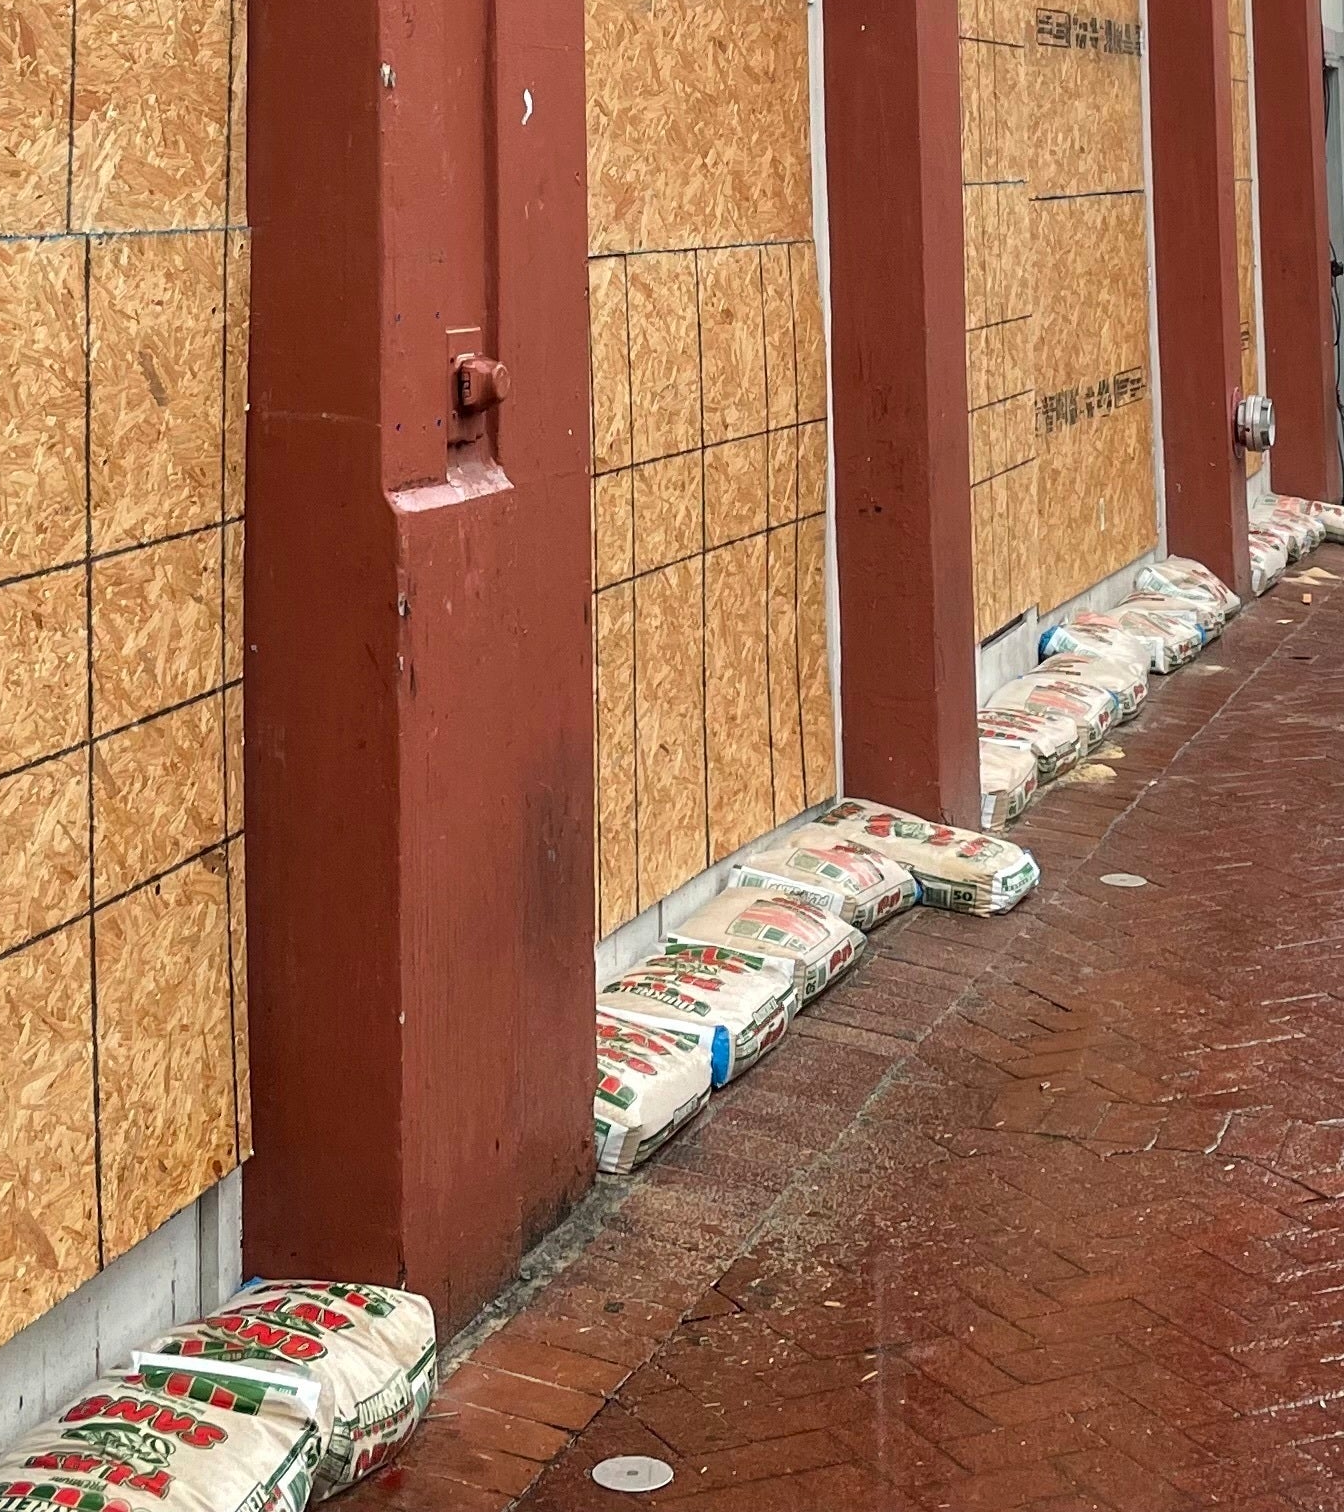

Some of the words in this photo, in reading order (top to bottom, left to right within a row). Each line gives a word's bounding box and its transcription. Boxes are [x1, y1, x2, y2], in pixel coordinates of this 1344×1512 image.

[952, 890, 973, 902] 50
[58, 1395, 229, 1450] SAND
[21, 1452, 178, 1500] PLAY
